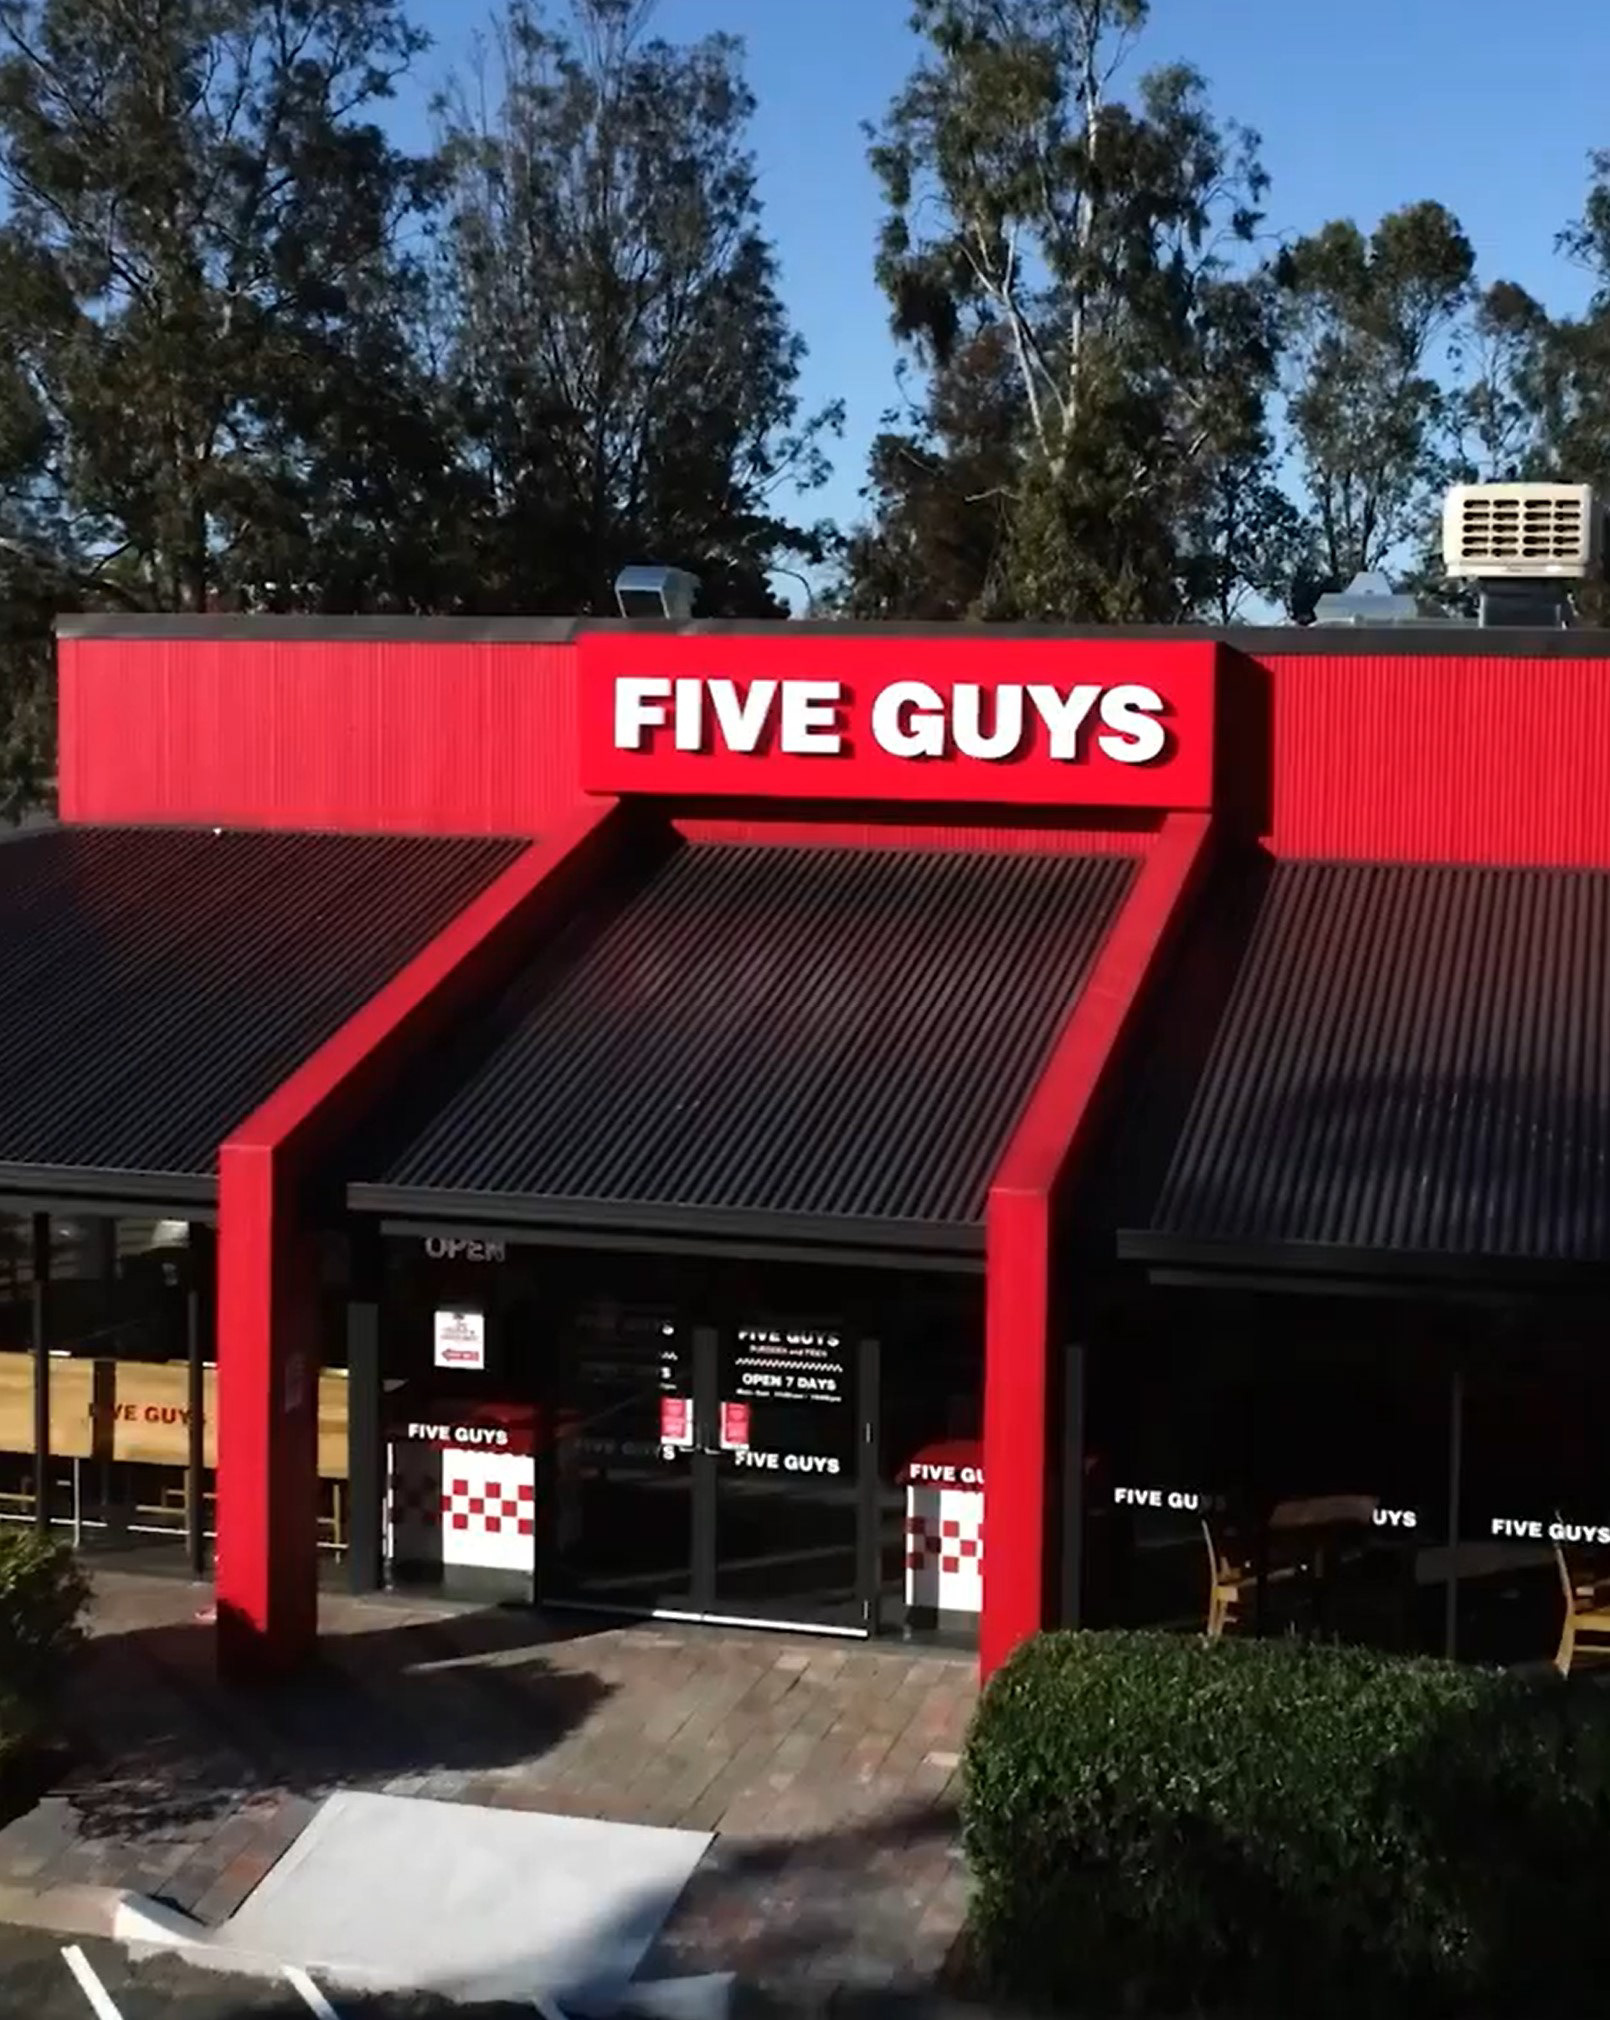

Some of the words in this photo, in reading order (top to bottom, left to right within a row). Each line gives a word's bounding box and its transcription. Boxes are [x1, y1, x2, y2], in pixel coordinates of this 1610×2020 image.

[613, 676, 842, 754] FIVE
[871, 681, 1167, 764] GUYS
[425, 1237, 506, 1263] OPEN
[741, 1373, 782, 1387] OPEN
[785, 1375, 796, 1389] 7
[797, 1378, 837, 1392] DAYS
[145, 1406, 207, 1425] GUY
[407, 1422, 451, 1441] FIVE
[455, 1427, 509, 1446] GUYS
[734, 1450, 780, 1469] FIVE
[783, 1453, 840, 1474] GUYS
[909, 1463, 956, 1483] FIVE
[960, 1466, 985, 1485] GU
[1113, 1487, 1163, 1508] FIVE
[1371, 1508, 1417, 1528] UYS
[1490, 1518, 1543, 1538] FIVE
[1547, 1523, 1610, 1544] GUYS
